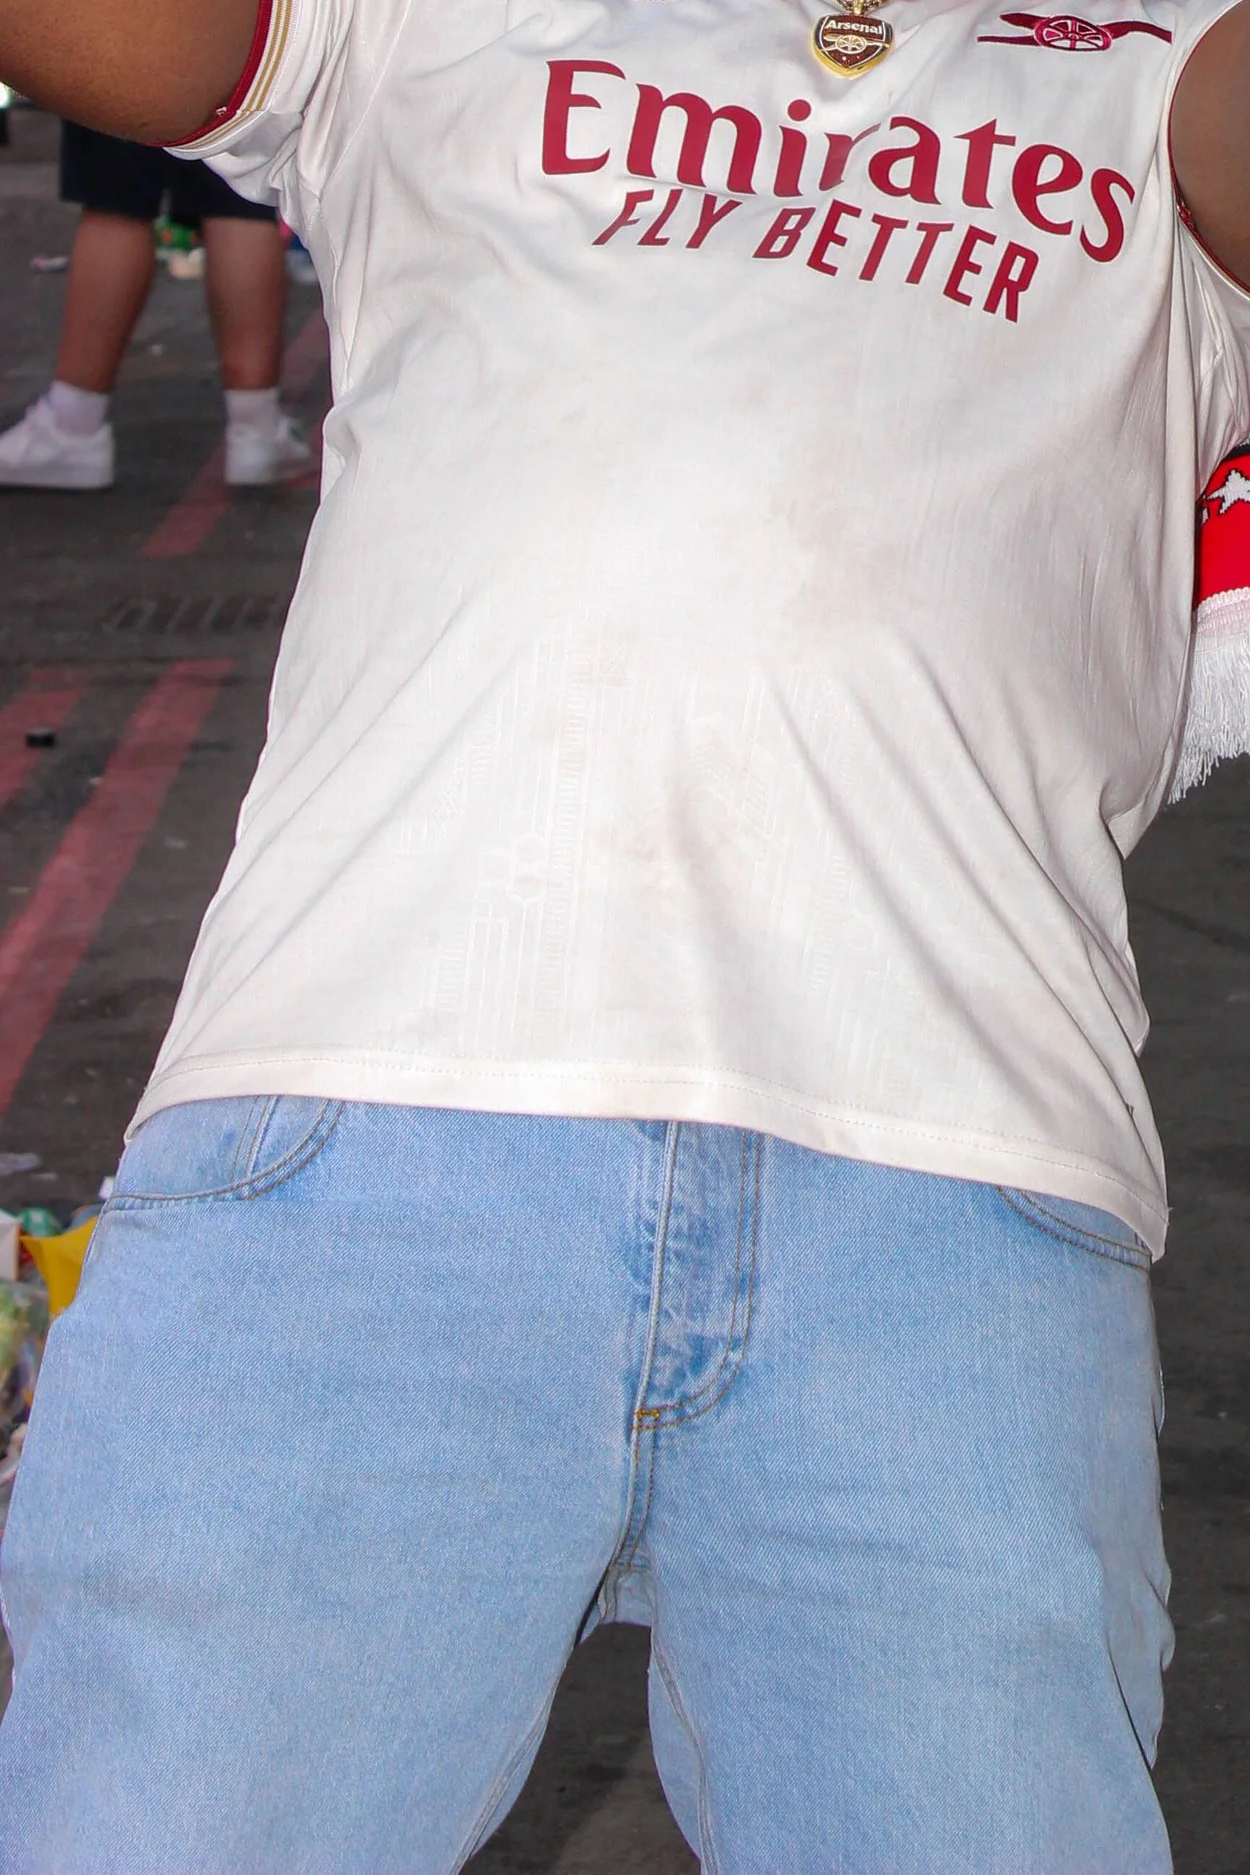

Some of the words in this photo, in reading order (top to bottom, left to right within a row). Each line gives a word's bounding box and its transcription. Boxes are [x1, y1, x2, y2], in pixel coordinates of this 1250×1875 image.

[824, 19, 883, 35] Arsenal
[541, 59, 1135, 263] Emirates
[591, 187, 742, 250] FLY
[752, 198, 1041, 324] BETTER
